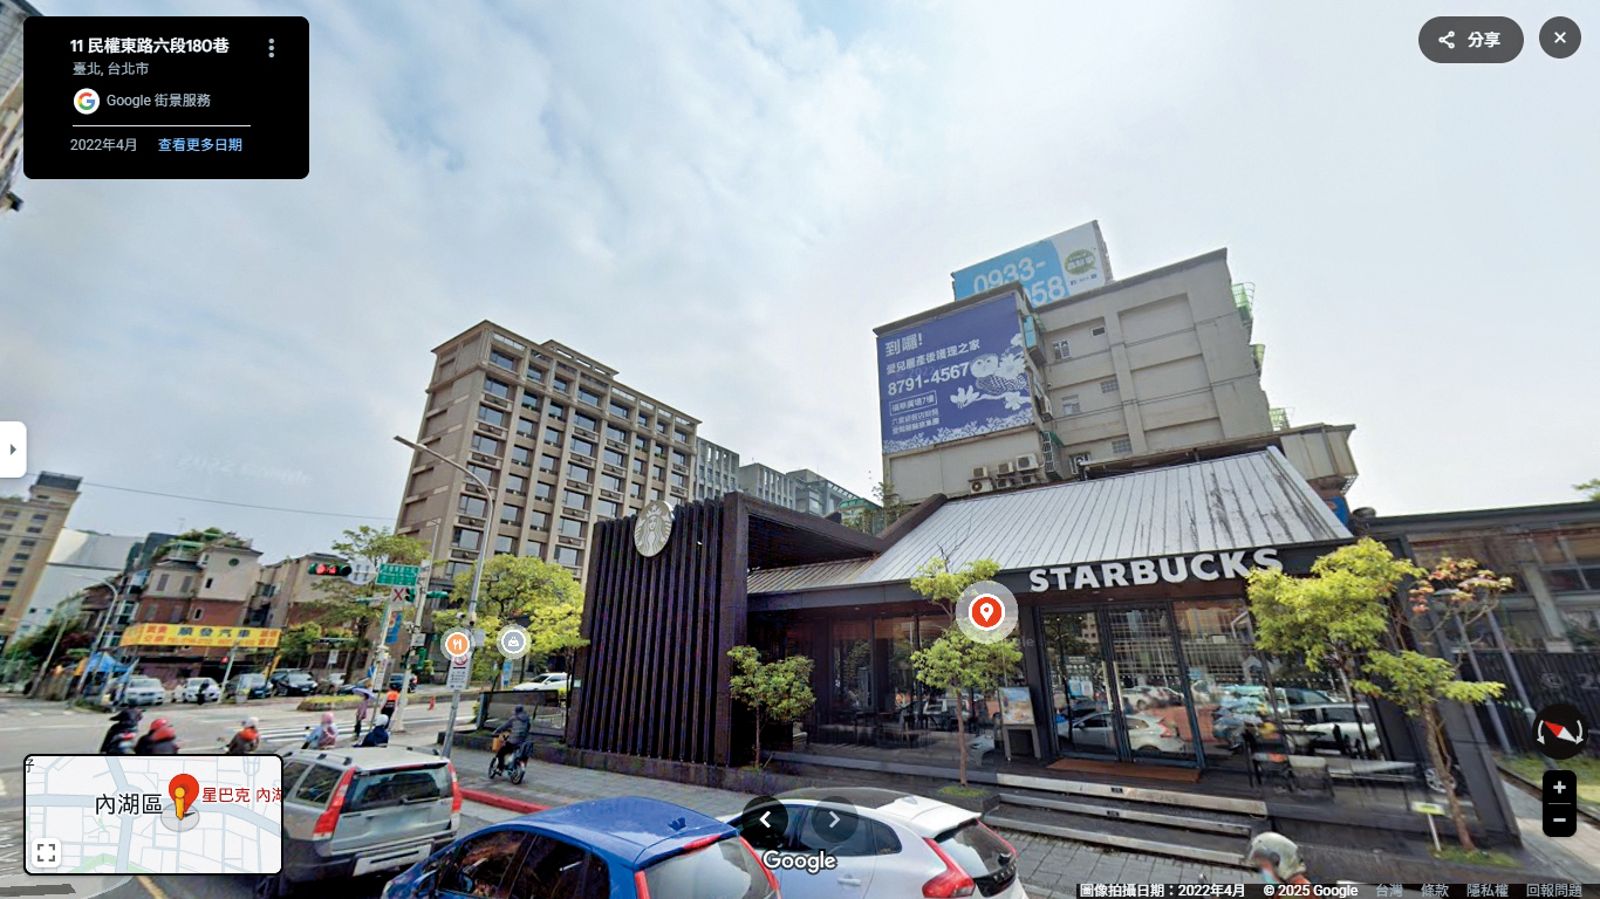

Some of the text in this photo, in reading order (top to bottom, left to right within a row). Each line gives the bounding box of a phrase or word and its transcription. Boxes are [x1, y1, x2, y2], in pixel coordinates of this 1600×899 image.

[973, 257, 1046, 294] 0933-
[1024, 274, 1066, 307] 58
[888, 362, 970, 396] 8791-4567
[1029, 548, 1284, 593] STARBUCKS
